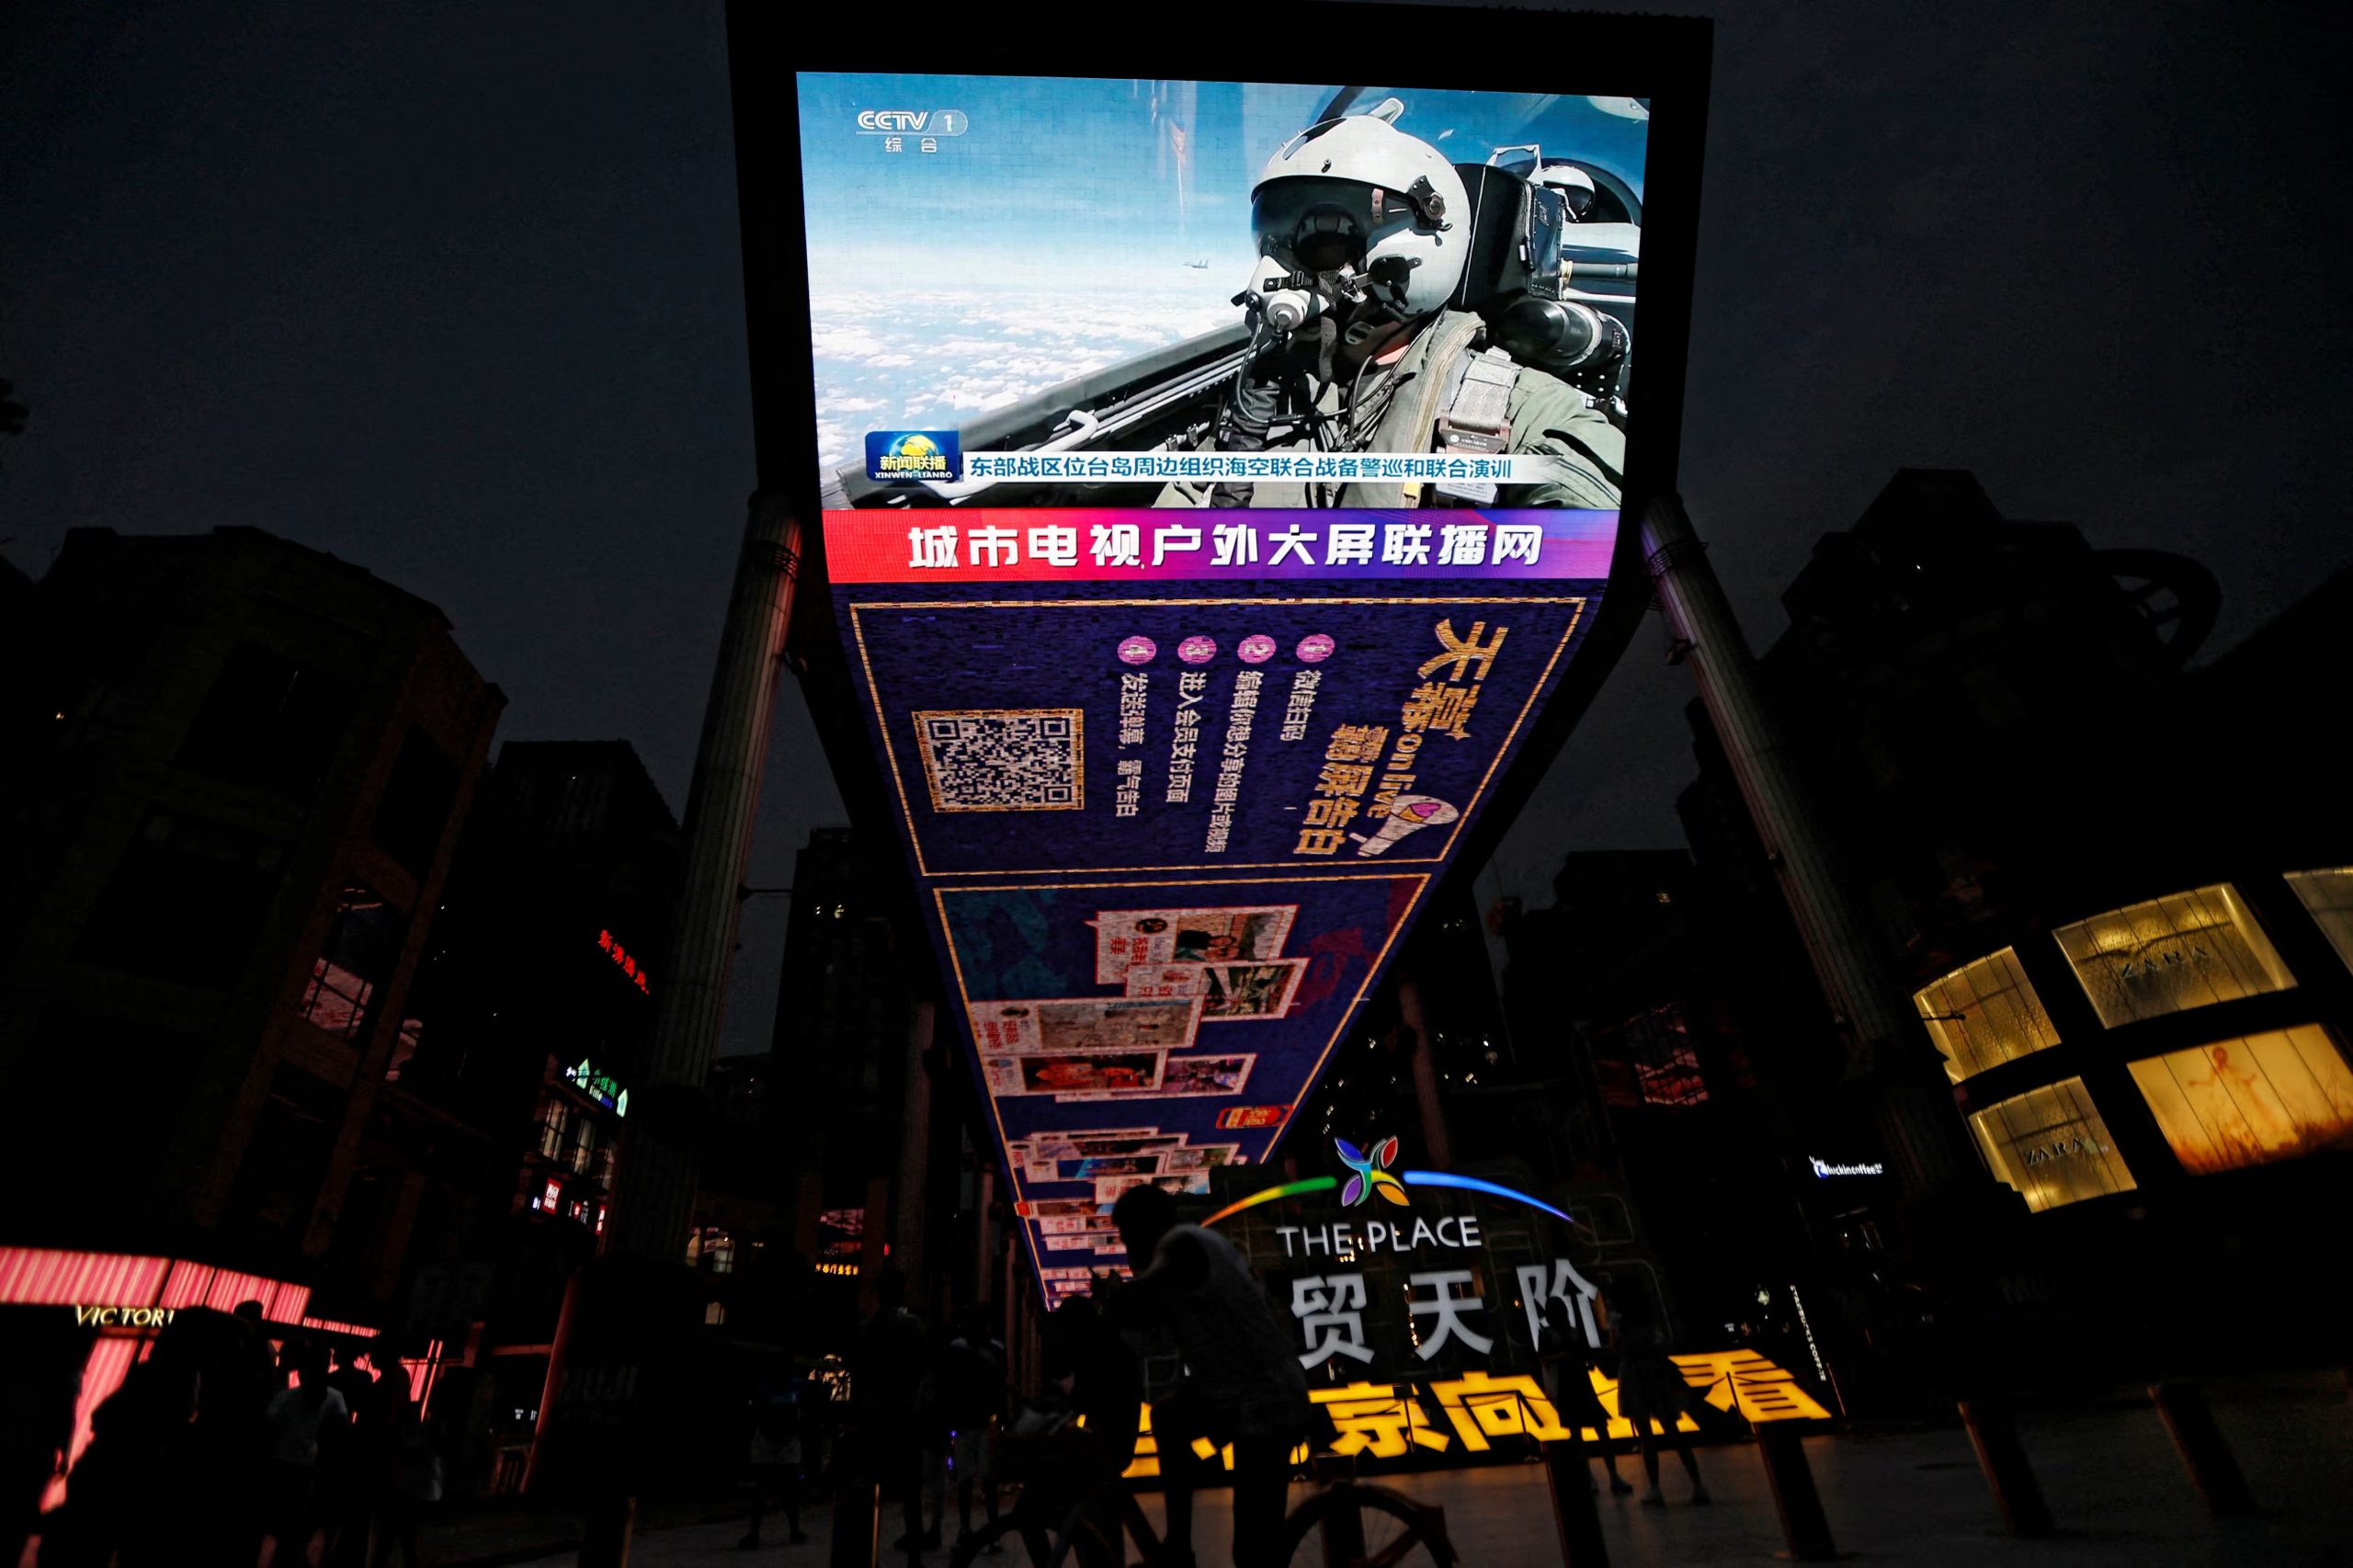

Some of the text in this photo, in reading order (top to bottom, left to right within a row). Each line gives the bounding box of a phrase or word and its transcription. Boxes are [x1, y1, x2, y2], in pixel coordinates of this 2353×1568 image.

[858, 111, 953, 131] CCTV 1
[885, 137, 938, 153] 综合
[880, 455, 947, 472] 新闻联播
[970, 456, 1512, 479] 东部战区位台岛周边组织海空联合战备警巡和联合演训
[908, 523, 1544, 569] 城市电视户外大屏联播网
[1401, 618, 1509, 733] 天幕
[1279, 669, 1323, 741] 微信扫码
[1165, 671, 1207, 803] 进入会员支付页面
[1387, 733, 1424, 770] on
[1203, 669, 1264, 853] 编辑你想分享的图片或视频
[1292, 722, 1391, 855] 霸屏告白
[2122, 946, 2208, 979] ZARA
[2028, 1136, 2087, 1165] ZARA
[1276, 1216, 1482, 1257] THE PLACE
